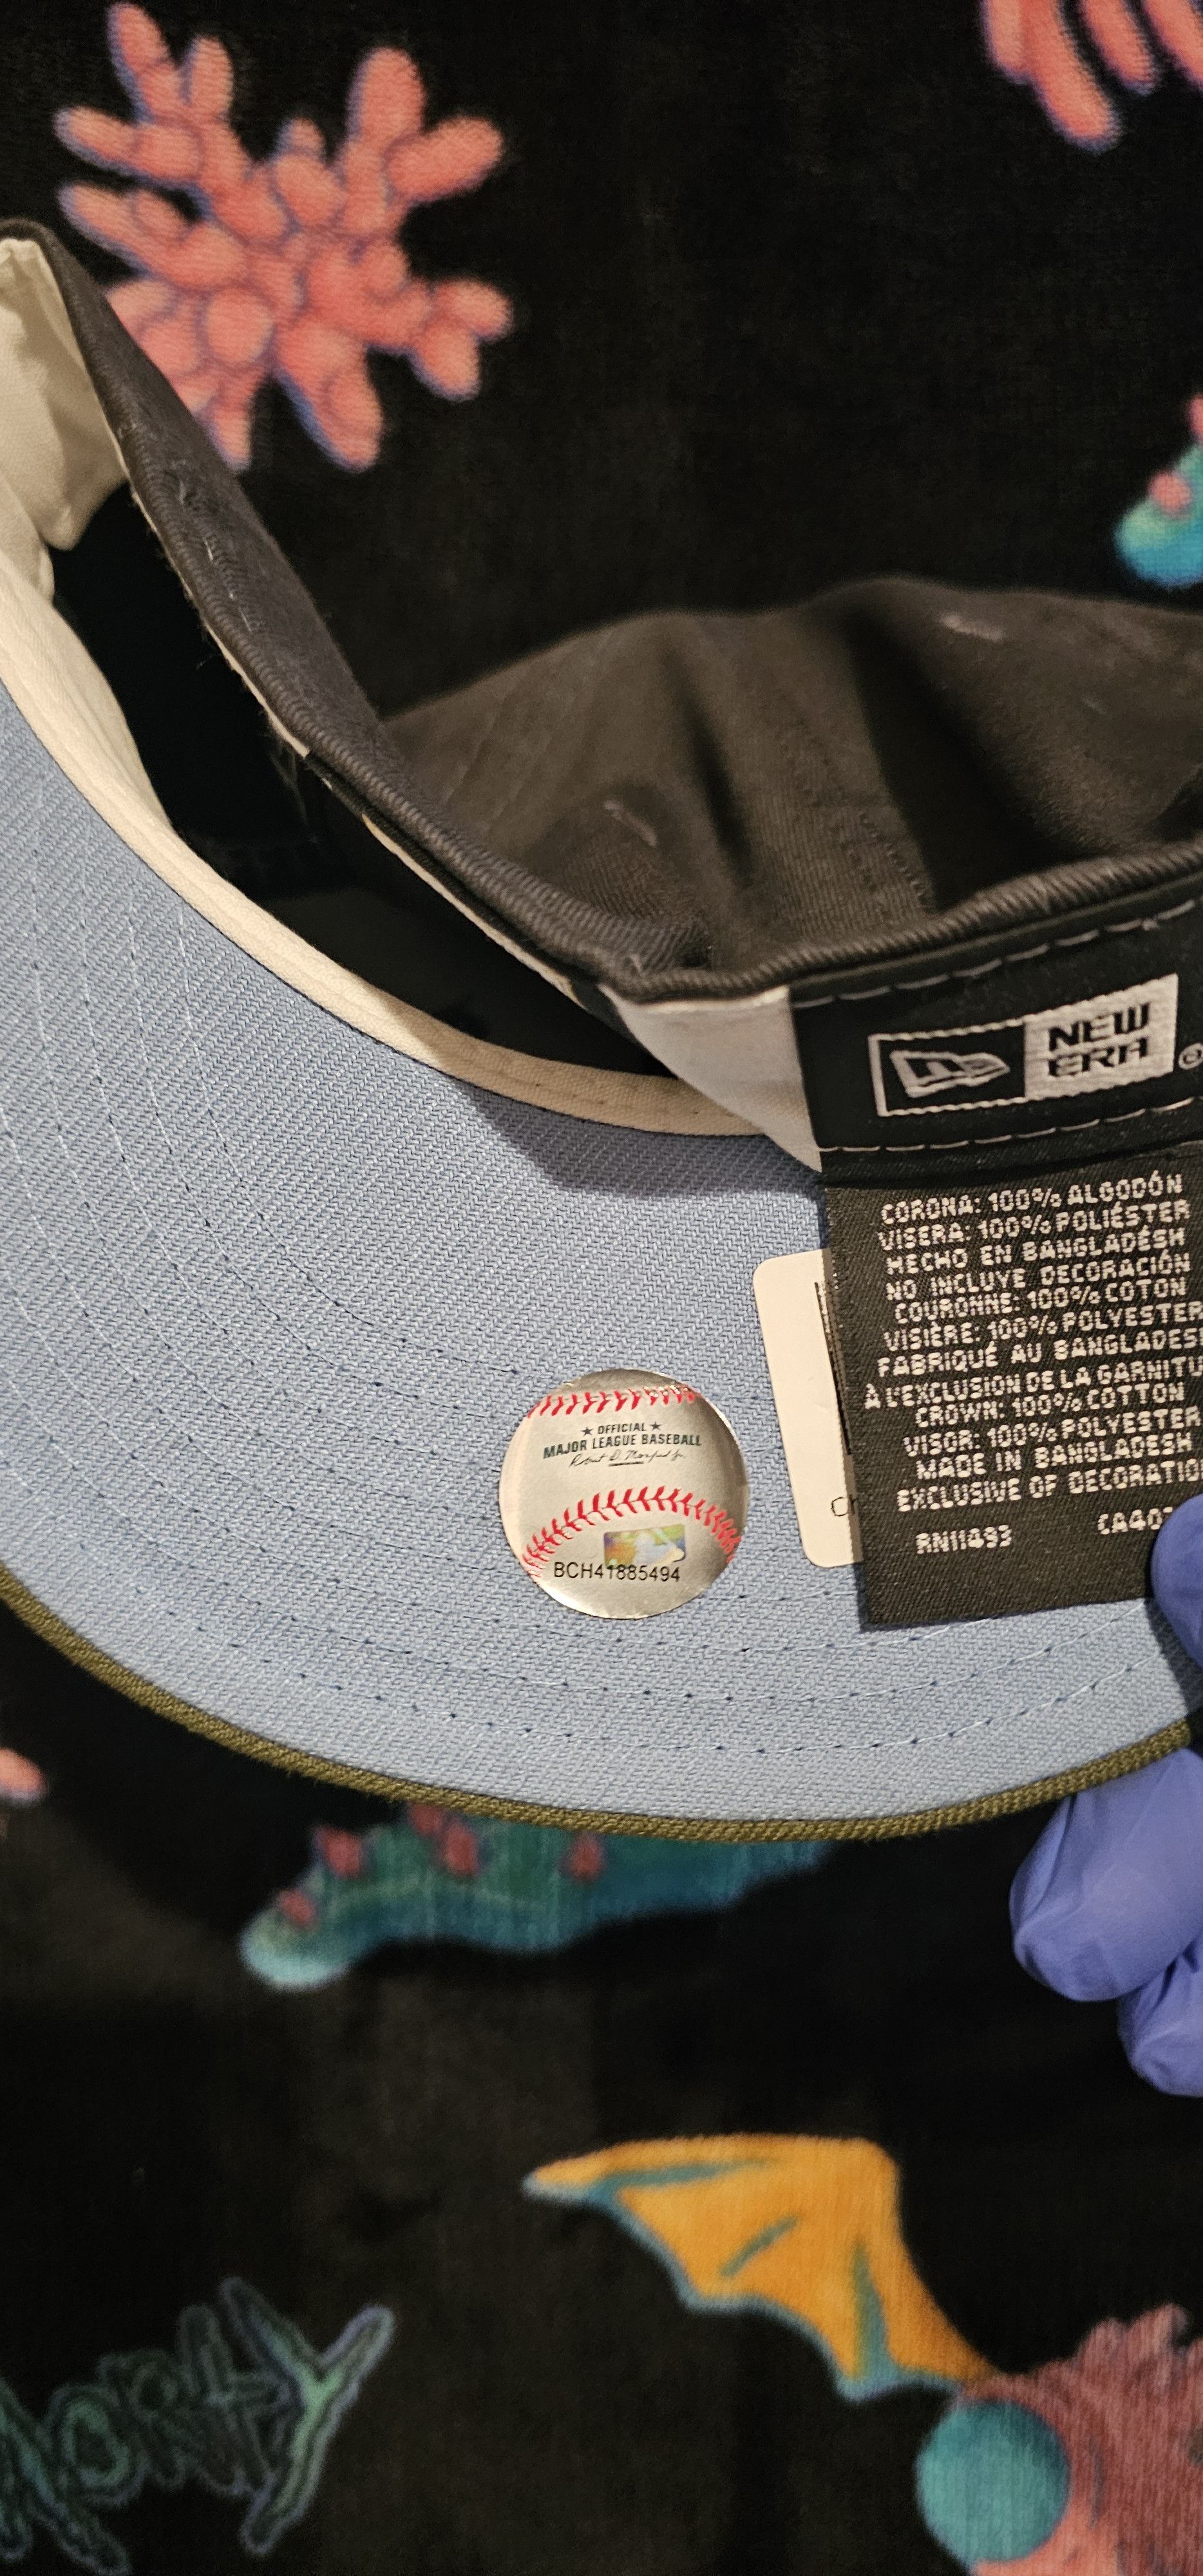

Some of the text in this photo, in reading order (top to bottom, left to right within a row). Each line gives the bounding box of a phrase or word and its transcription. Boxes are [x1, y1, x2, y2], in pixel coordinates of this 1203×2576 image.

[1048, 1001, 1150, 1051] NEW
[1048, 1037, 1149, 1077] ERA
[881, 1170, 1183, 1224] CORONA: 100% ALGODÓN
[878, 1199, 1191, 1251] VISERA: 100% POLIÉSTER
[886, 1224, 1186, 1274] HECHO EN BANGLADÉSH
[886, 1253, 1191, 1300] NO INCLUYE DECORACIÓN
[895, 1277, 1186, 1324] COURONNE: 100% COTON
[883, 1301, 1203, 1352] VISIÈRE: 100% POLYESTER
[878, 1341, 998, 1378] FABRIQUÉ
[1011, 1343, 1041, 1364] AU
[1026, 1370, 1055, 1393] DE
[1059, 1366, 1092, 1389] LA
[597, 1422, 646, 1434] OFFICIAL
[915, 1381, 1185, 1428] CROWN: 100% COTTON
[543, 1433, 702, 1459] MAJOR LEAGUE BASEBALL
[903, 1405, 1201, 1457] VISOR: 100% POLYESTER
[916, 1432, 1193, 1480] MADE IN BANGLADESH
[896, 1477, 1021, 1512] EXCLUSIVE
[1029, 1474, 1058, 1499] OF
[916, 1524, 1012, 1555] RN11493
[1097, 1506, 1173, 1535] CA40
[553, 1561, 681, 1582] BCH41885494
